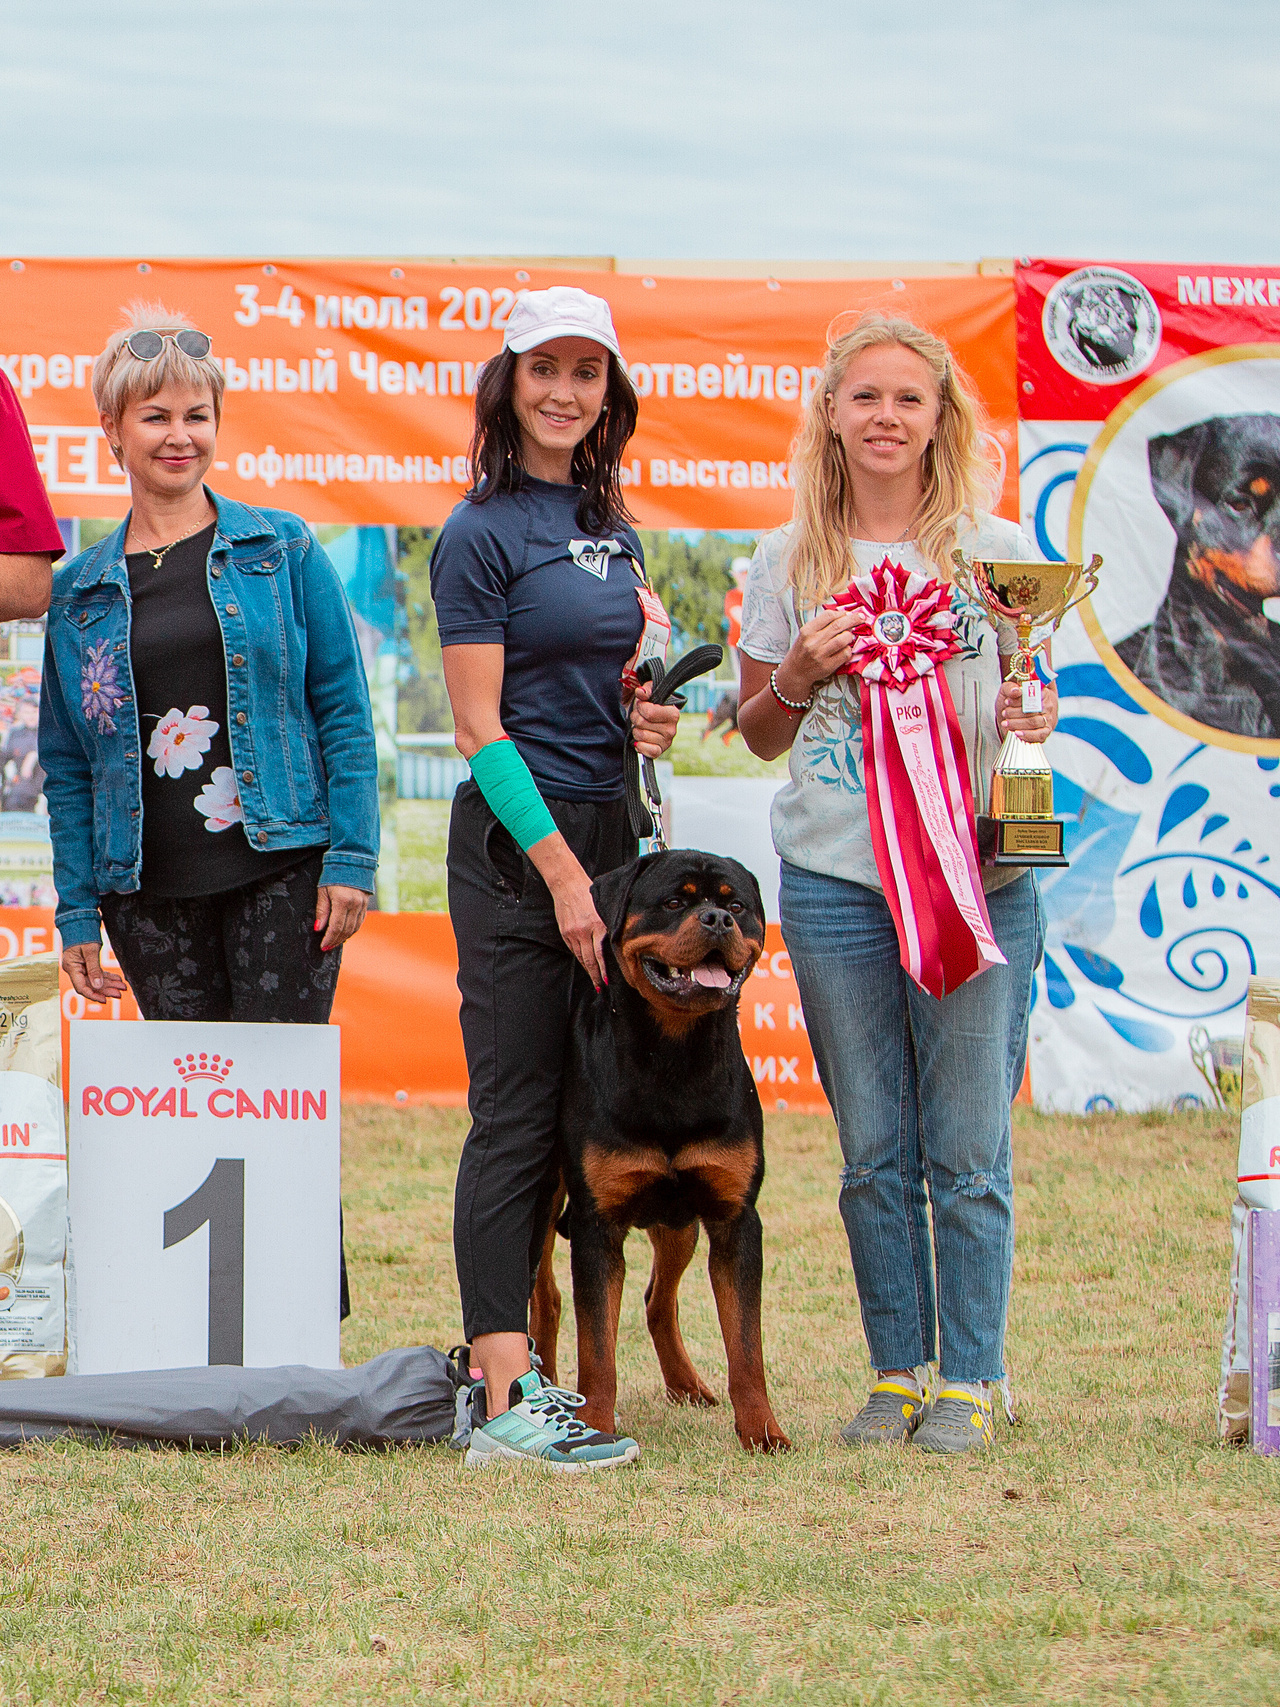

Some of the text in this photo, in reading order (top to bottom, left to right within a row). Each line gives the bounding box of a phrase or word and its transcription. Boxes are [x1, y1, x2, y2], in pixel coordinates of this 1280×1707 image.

[234, 284, 526, 330] 3-4 июля 202
[235, 445, 471, 488] официальные
[896, 704, 922, 721] РКФ
[11, 1012, 28, 1029] kg
[82, 1085, 327, 1120] ROYAL CANIN
[163, 1157, 245, 1366] 1
